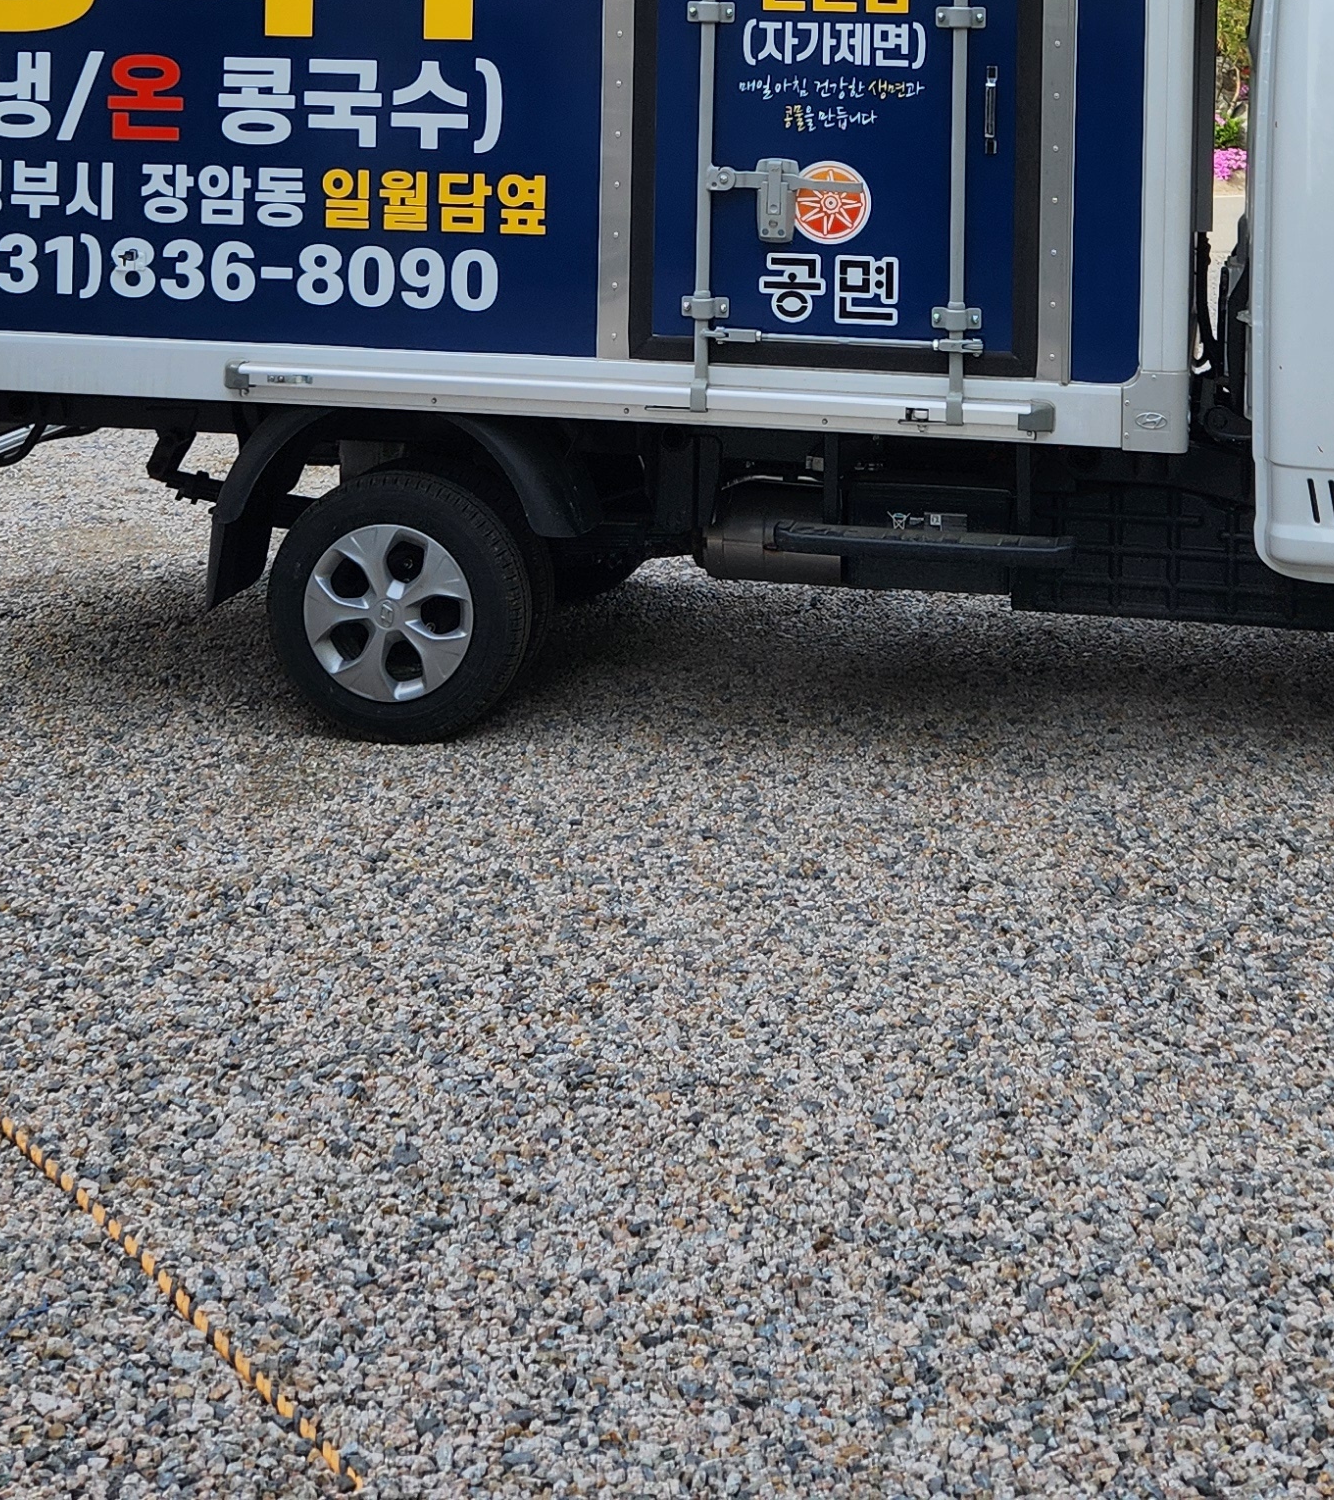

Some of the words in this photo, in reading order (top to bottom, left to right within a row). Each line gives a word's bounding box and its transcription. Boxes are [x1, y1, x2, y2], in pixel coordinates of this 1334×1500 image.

[743, 19, 927, 69] (자가제면)
[218, 56, 503, 154] 콩국수)
[814, 76, 866, 100] 건강한
[818, 107, 878, 131] 만듭니다
[141, 163, 306, 227] 장암동
[322, 168, 547, 235] 일월담옆
